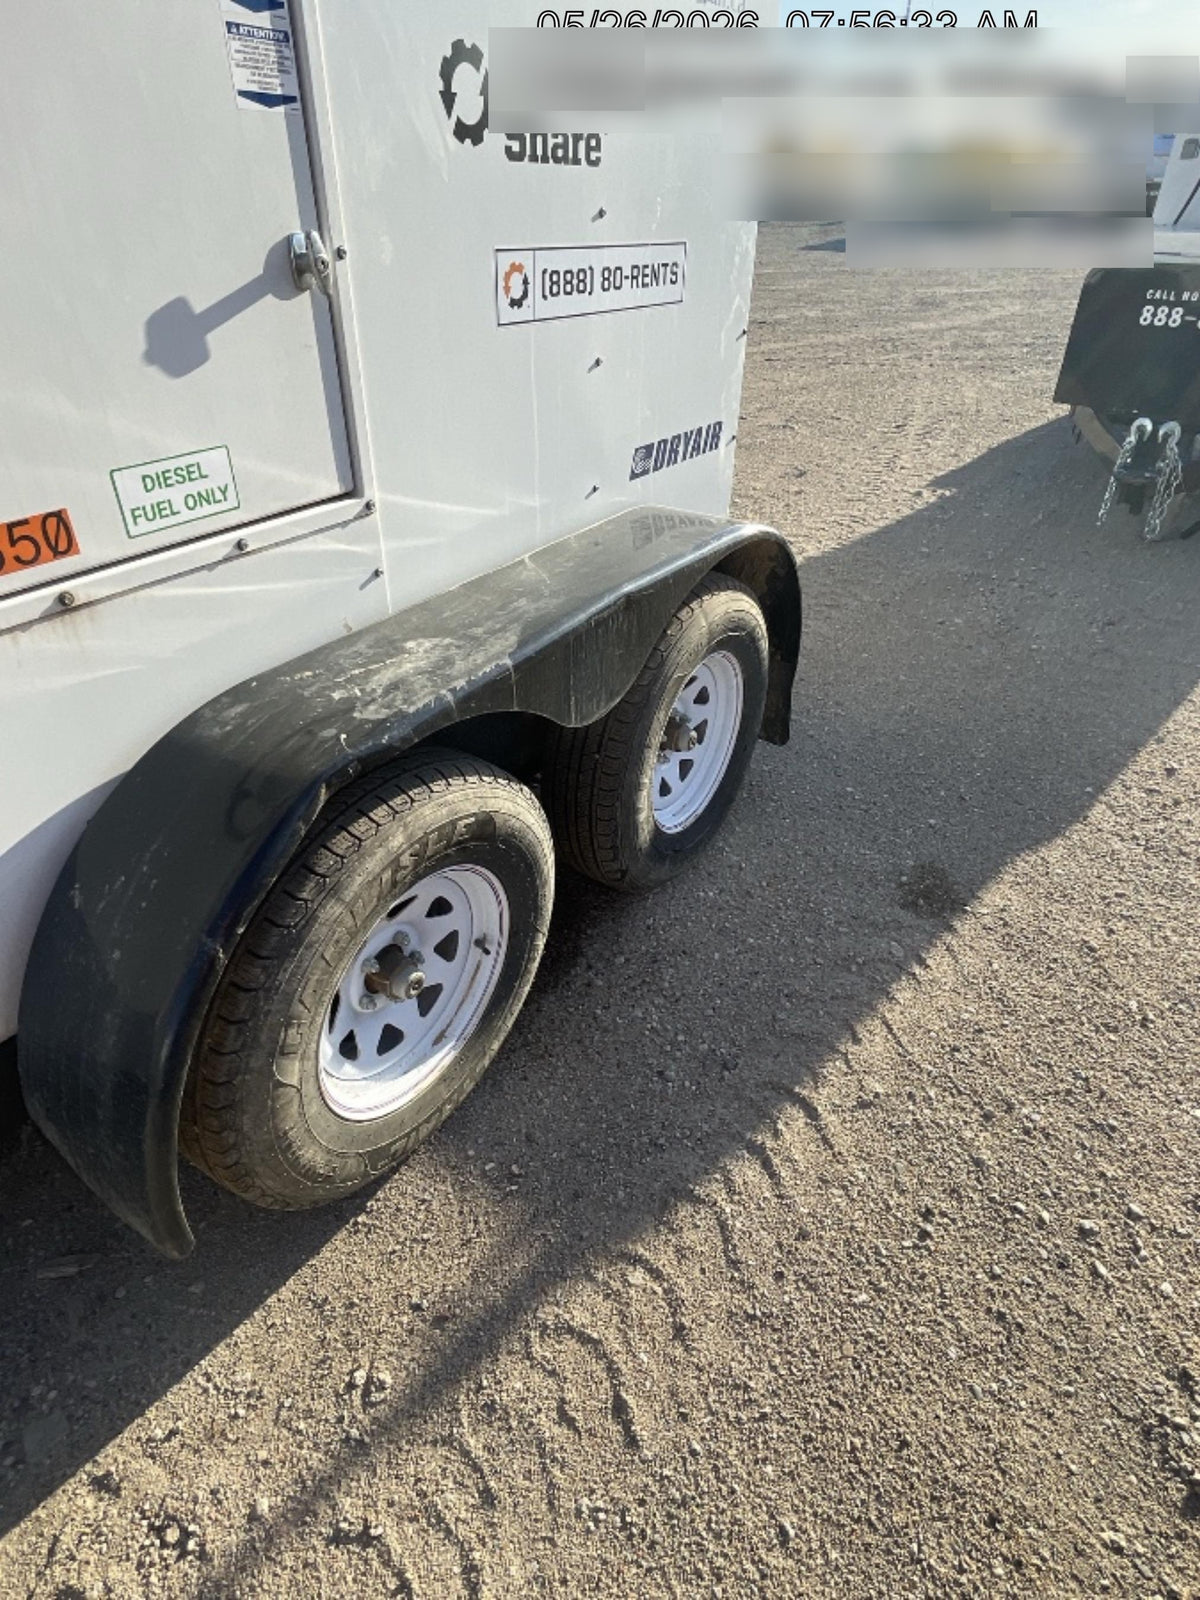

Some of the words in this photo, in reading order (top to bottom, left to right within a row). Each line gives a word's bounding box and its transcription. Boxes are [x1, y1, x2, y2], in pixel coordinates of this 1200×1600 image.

[542, 266, 594, 301] (888)
[601, 262, 679, 292] 80-RENTS
[1146, 289, 1175, 301] CALL
[1139, 305, 1200, 330] 888-
[652, 421, 723, 473] DRYAIR
[141, 461, 209, 493] DIESEL
[130, 499, 181, 526] FUEL
[184, 483, 229, 511] ONLY
[0, 510, 73, 571] 50
